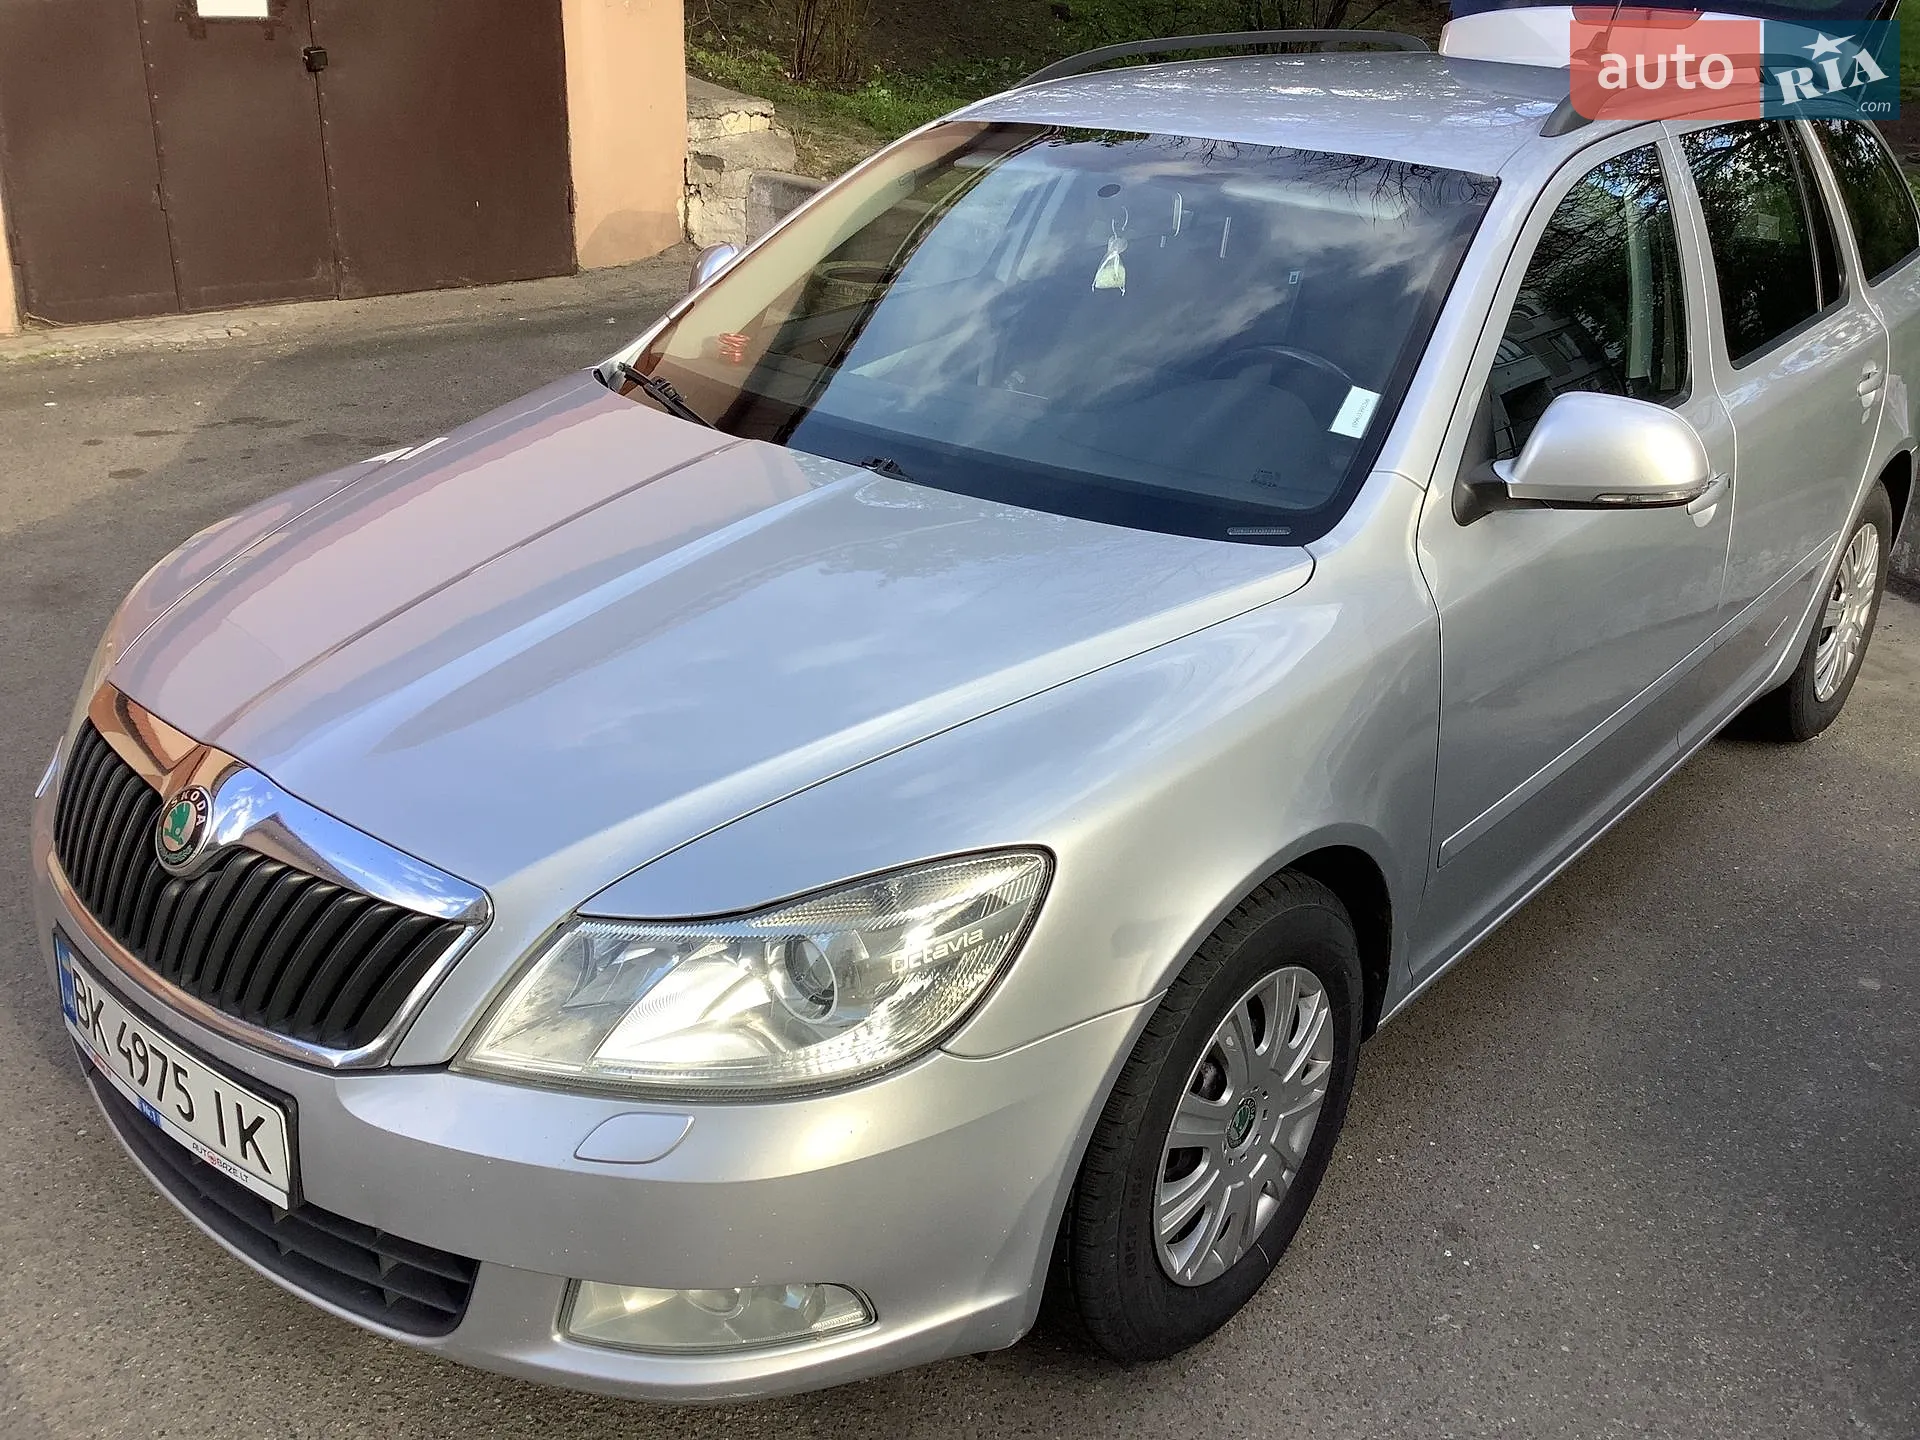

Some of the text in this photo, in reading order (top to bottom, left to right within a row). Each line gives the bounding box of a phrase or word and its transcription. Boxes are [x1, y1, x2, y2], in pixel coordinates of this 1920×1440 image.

[72, 967, 112, 1057] BK
[116, 1021, 195, 1123] 4975
[214, 1089, 272, 1175] IK
